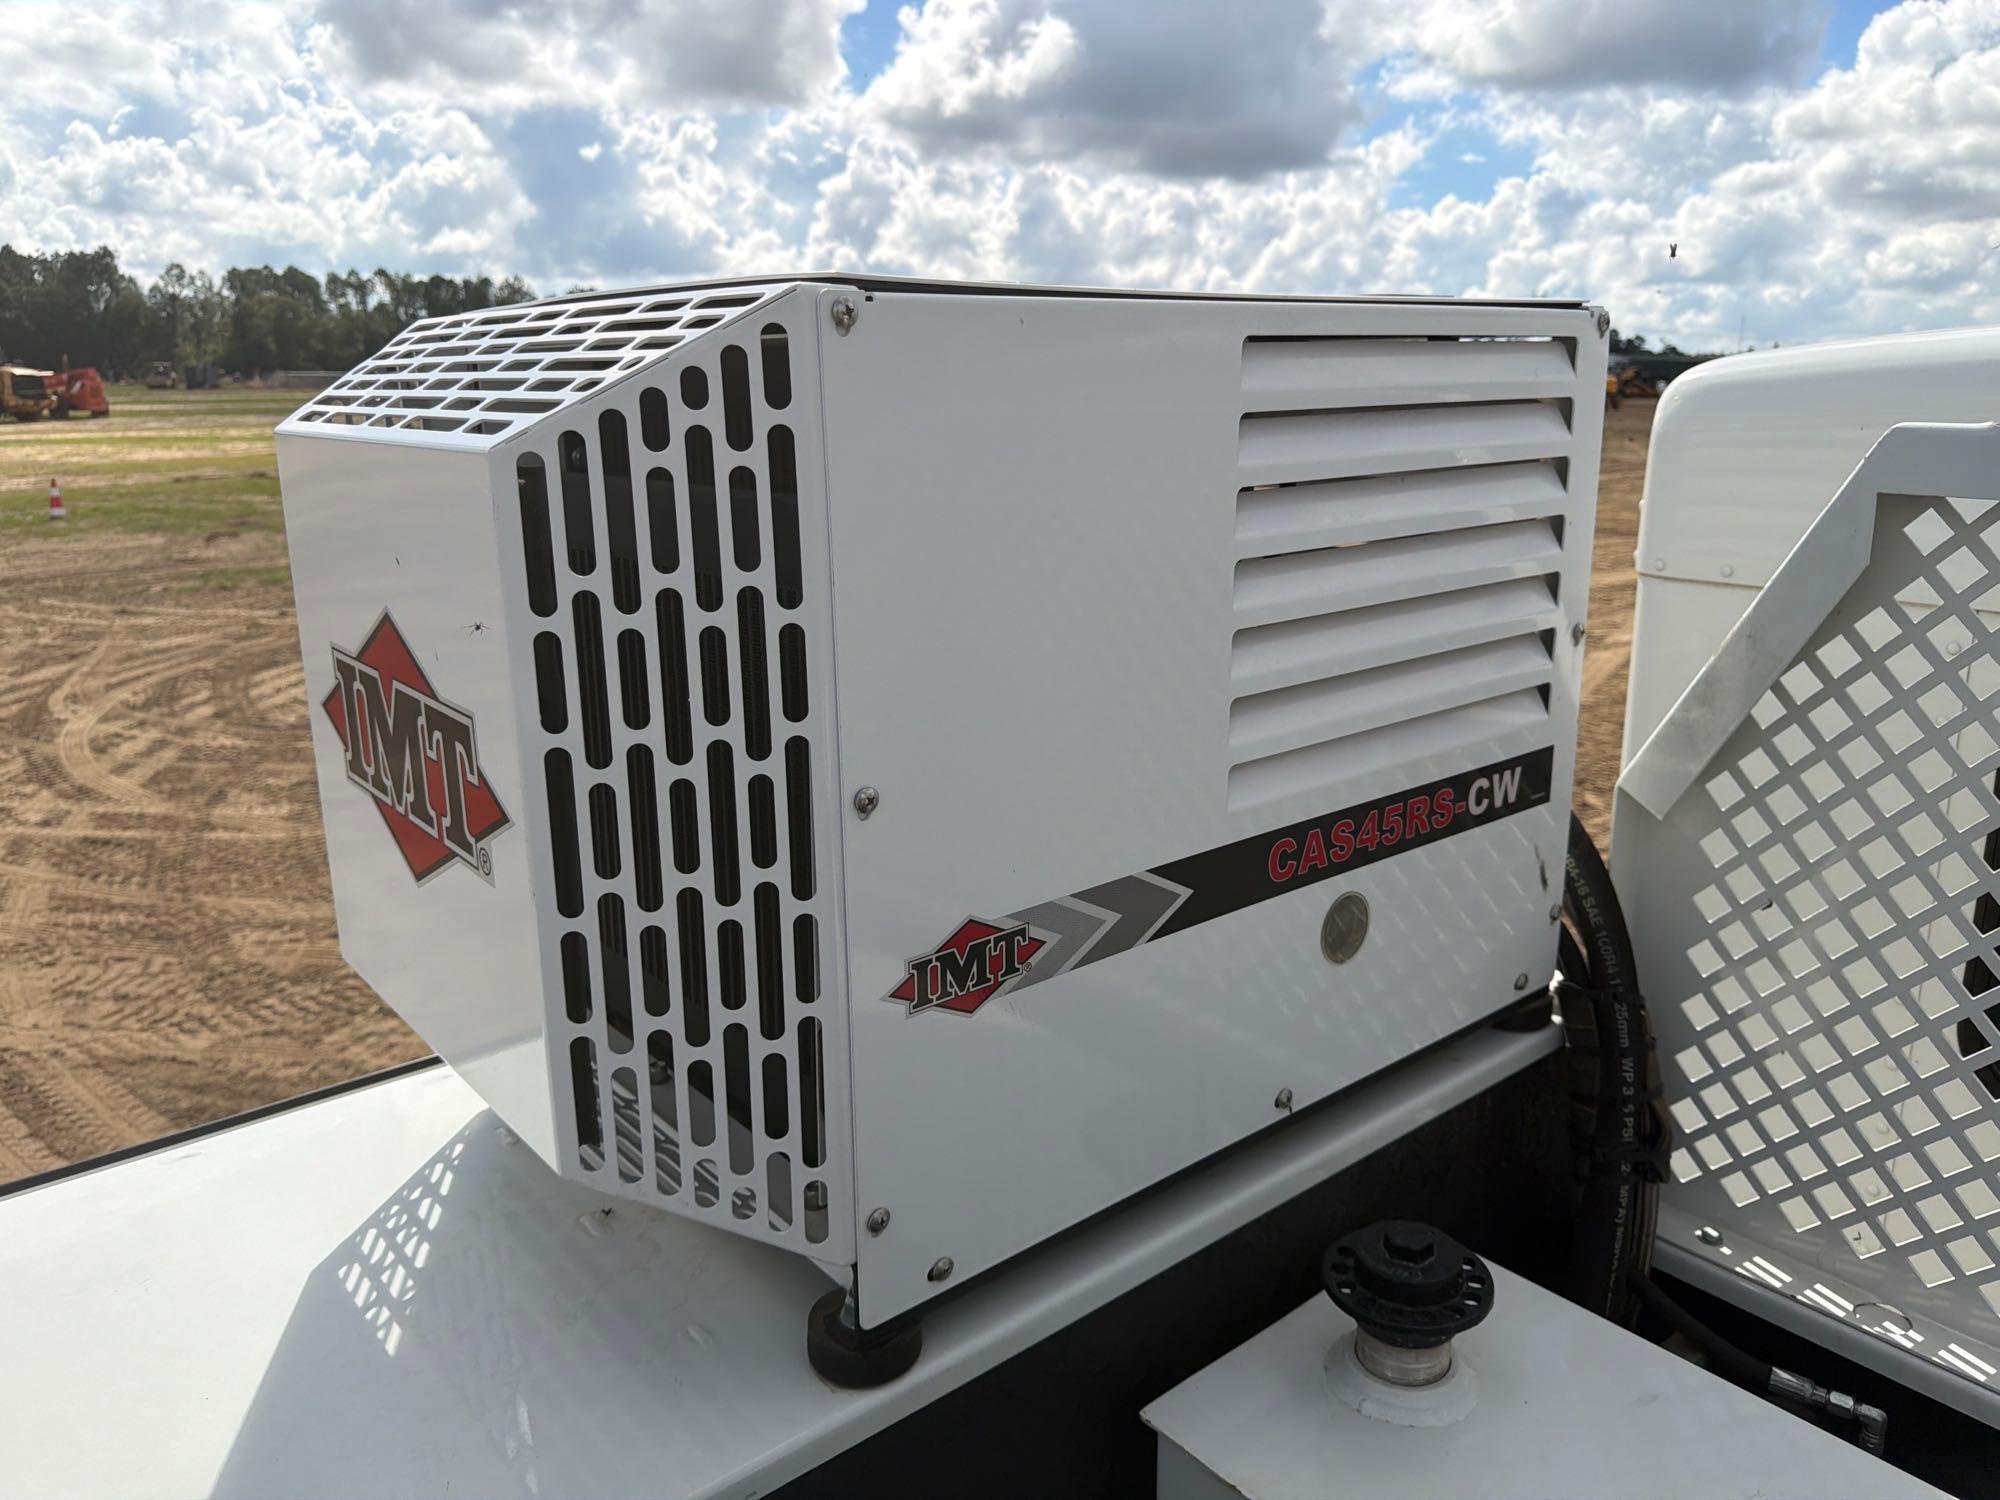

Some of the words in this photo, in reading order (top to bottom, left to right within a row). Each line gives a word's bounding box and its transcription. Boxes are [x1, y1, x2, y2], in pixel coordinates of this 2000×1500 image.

[332, 645, 479, 871] IMT
[1269, 766, 1522, 882] CAS45RS-CW
[1583, 896, 1604, 928] SAE
[909, 922, 1029, 1014] IMT
[1614, 1002, 1629, 1048] 25mm
[1621, 1057, 1634, 1083] WP
[1622, 1117, 1633, 1142] PSI
